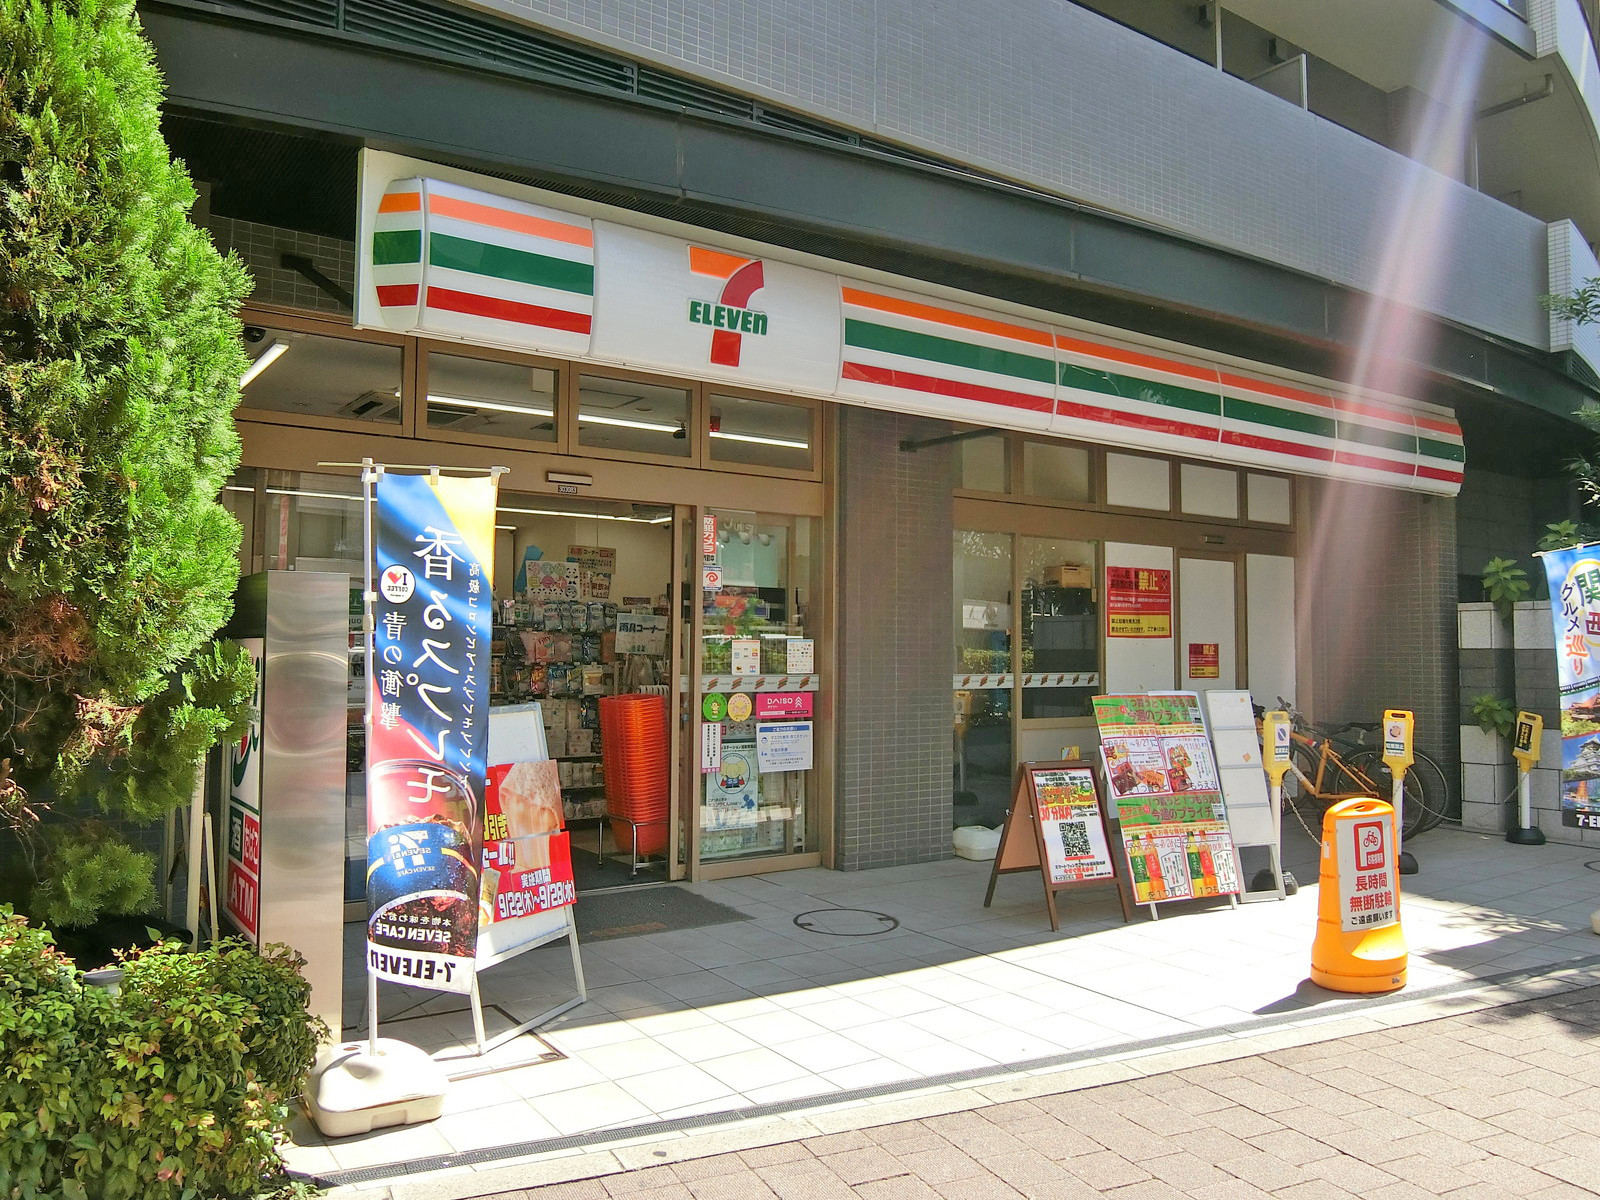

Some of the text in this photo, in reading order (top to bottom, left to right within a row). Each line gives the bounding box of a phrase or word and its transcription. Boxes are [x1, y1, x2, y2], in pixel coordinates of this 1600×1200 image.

[1561, 583, 1589, 675] グルメ巡り
[767, 697, 793, 705] DAISO
[1576, 813, 1600, 828] 7-E
[231, 815, 242, 852] 酒
[244, 823, 259, 865] たばこ
[520, 867, 552, 889] 実施期間
[1355, 872, 1388, 892] 長時間
[231, 871, 254, 922] ATM
[1349, 890, 1393, 913] 無断駐輪
[1351, 910, 1393, 925] ご遠慮願います
